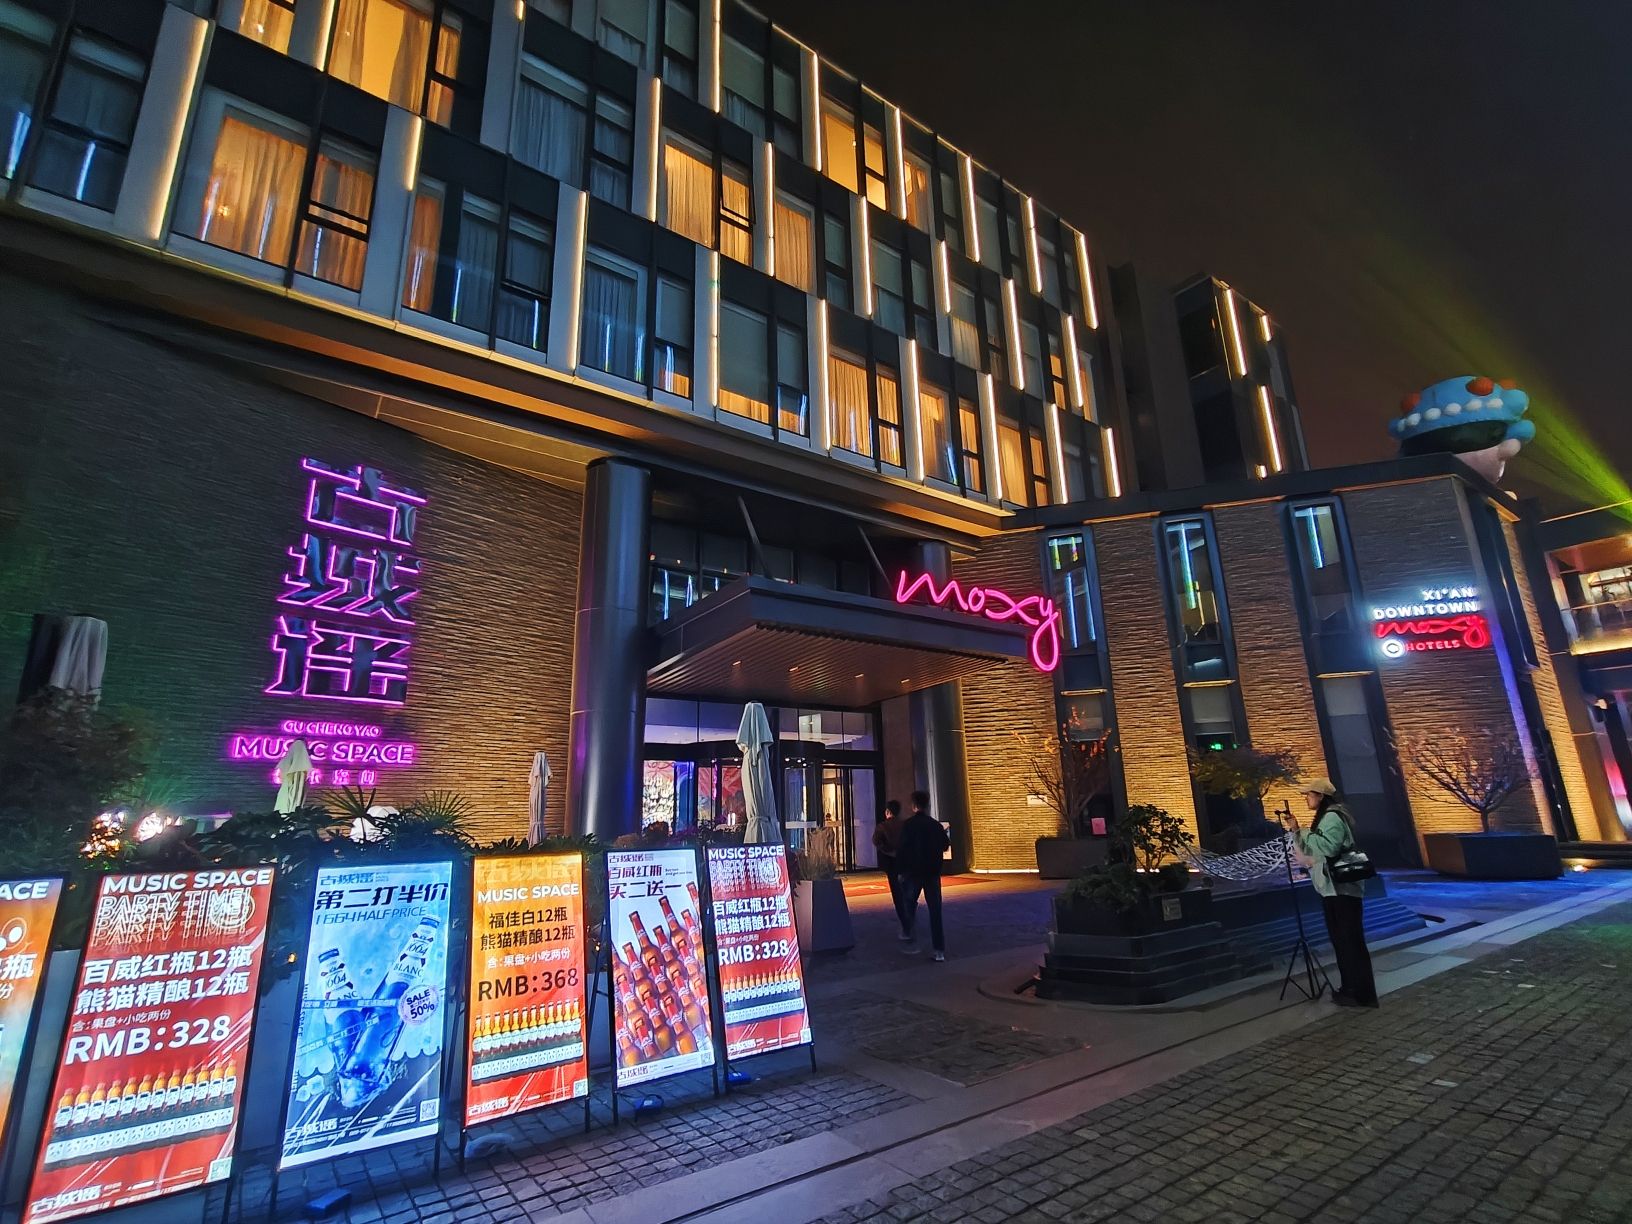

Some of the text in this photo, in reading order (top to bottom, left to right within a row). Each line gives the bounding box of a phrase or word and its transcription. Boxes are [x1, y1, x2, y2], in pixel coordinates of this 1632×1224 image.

[1373, 601, 1480, 619] DOWNTOWN
[1406, 640, 1460, 651] HOTELS
[332, 742, 414, 764] SPACE
[708, 845, 785, 860] MUSIC SPACE
[0, 882, 49, 900] ACE
[103, 869, 272, 894] MUSIC SPACE
[610, 880, 682, 899] 买二送一
[315, 882, 449, 910] 第二打半价
[478, 883, 579, 904] MUSIC SPACE
[391, 906, 428, 918] PRICE
[713, 895, 788, 917] 百威红瓶12瓶
[489, 906, 568, 929] 福佳白12瓶
[480, 925, 576, 951] 熊猫精酿12瓶
[84, 946, 253, 985] 百威红瓶12瓶
[74, 971, 251, 1016] 熊猫精酿12瓶
[406, 989, 431, 1005] SALE
[410, 1002, 435, 1019] 50%
